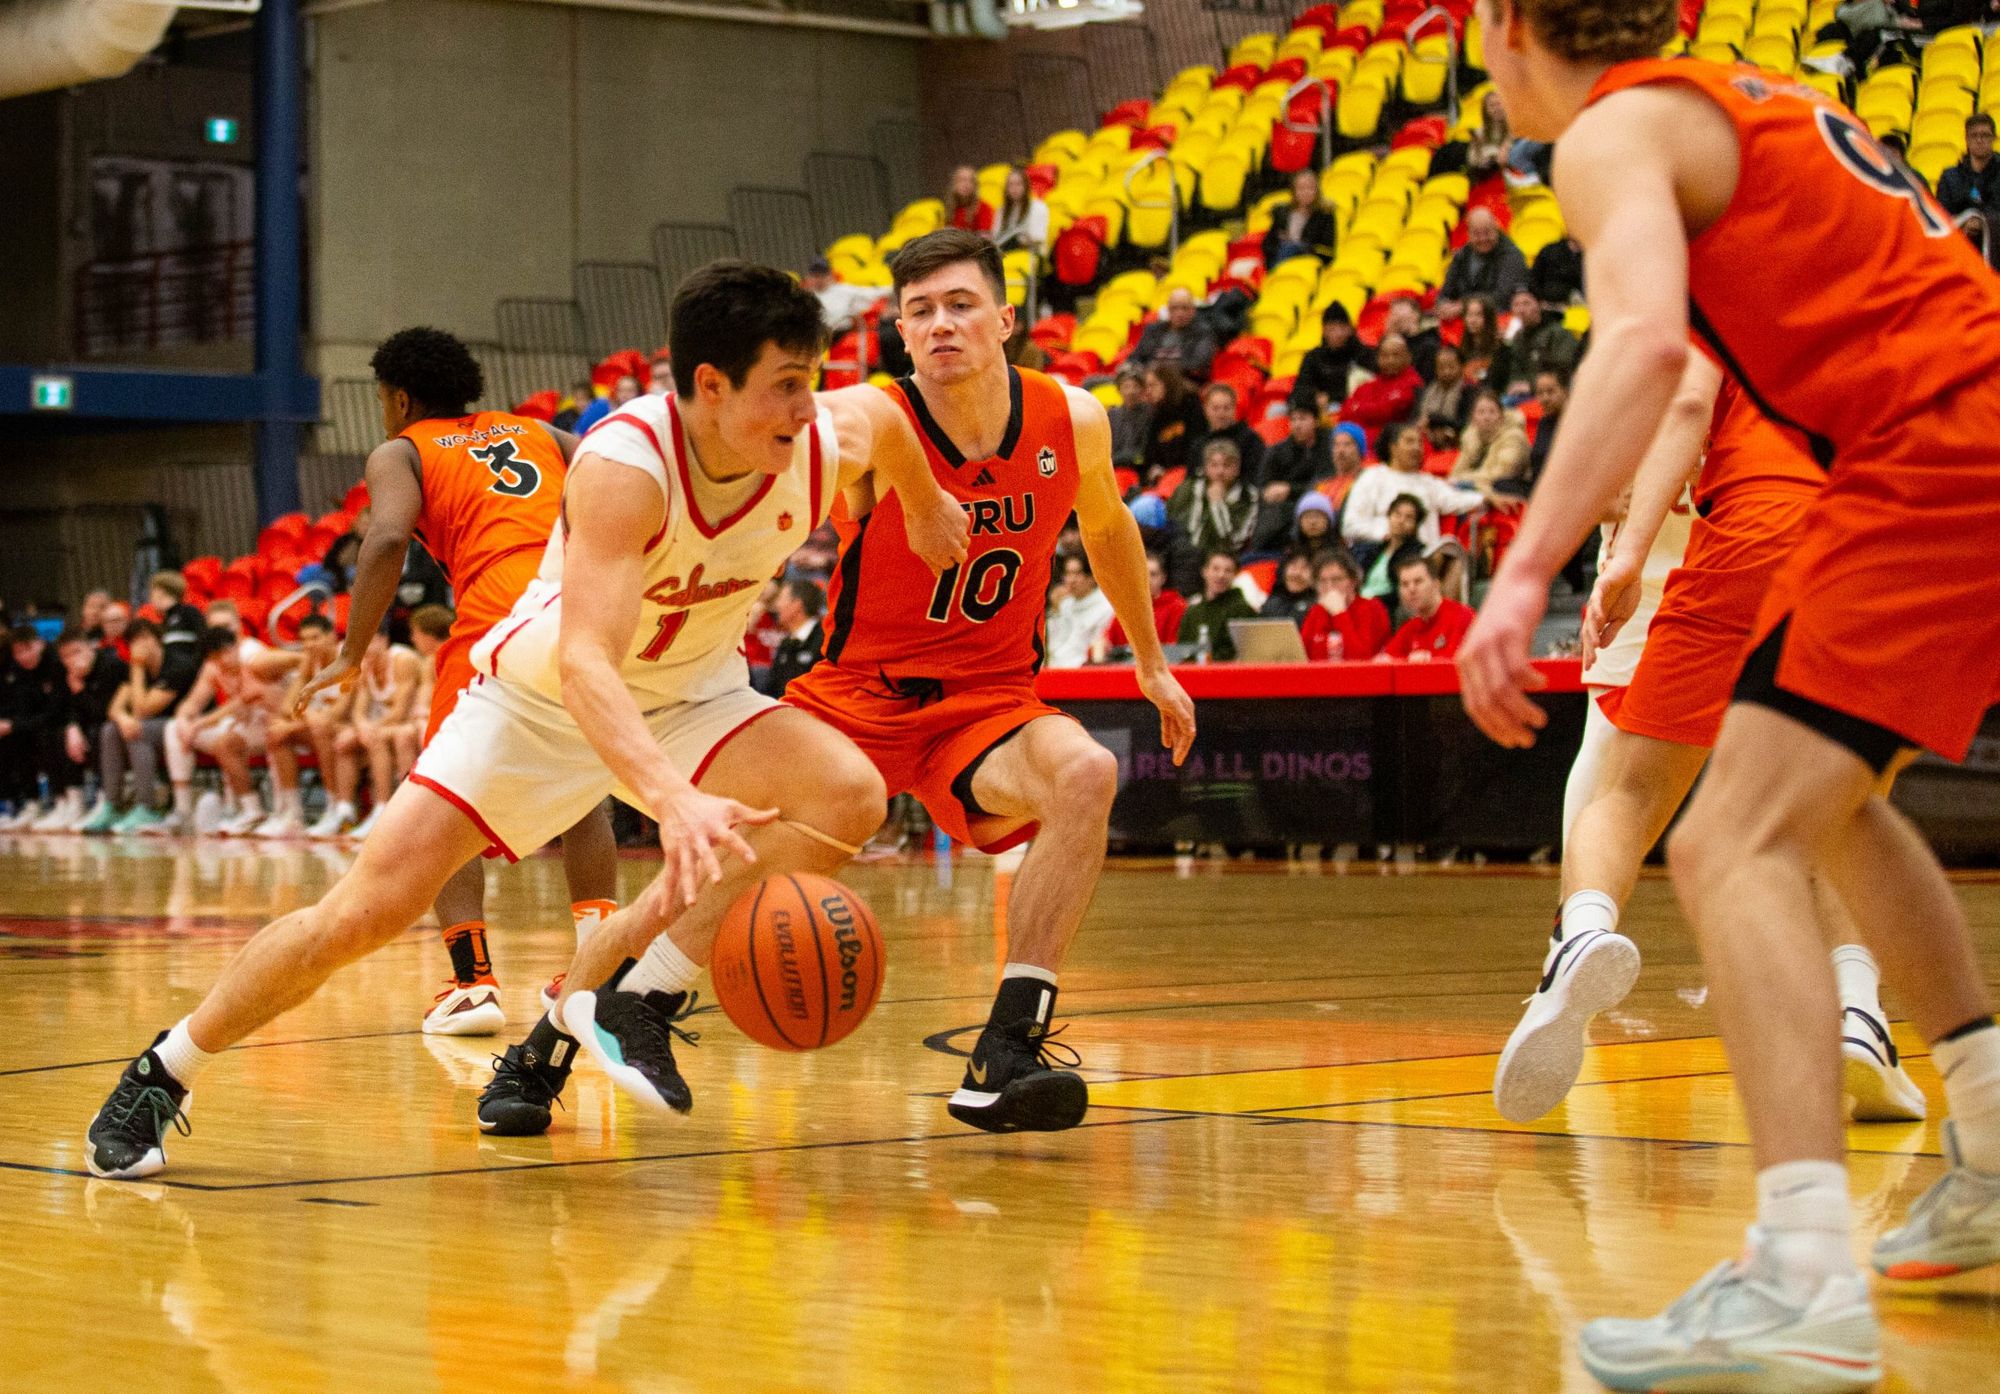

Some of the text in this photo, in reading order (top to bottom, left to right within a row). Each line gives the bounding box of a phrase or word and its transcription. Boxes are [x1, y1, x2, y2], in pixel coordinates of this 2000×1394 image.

[467, 437, 542, 499] 3
[960, 492, 1036, 535] RU
[926, 547, 1025, 624] 10
[636, 608, 690, 663] 1
[1262, 751, 1372, 781] DINOS
[772, 909, 809, 1020] EVOLUTION
[820, 895, 863, 1013] Wilson
